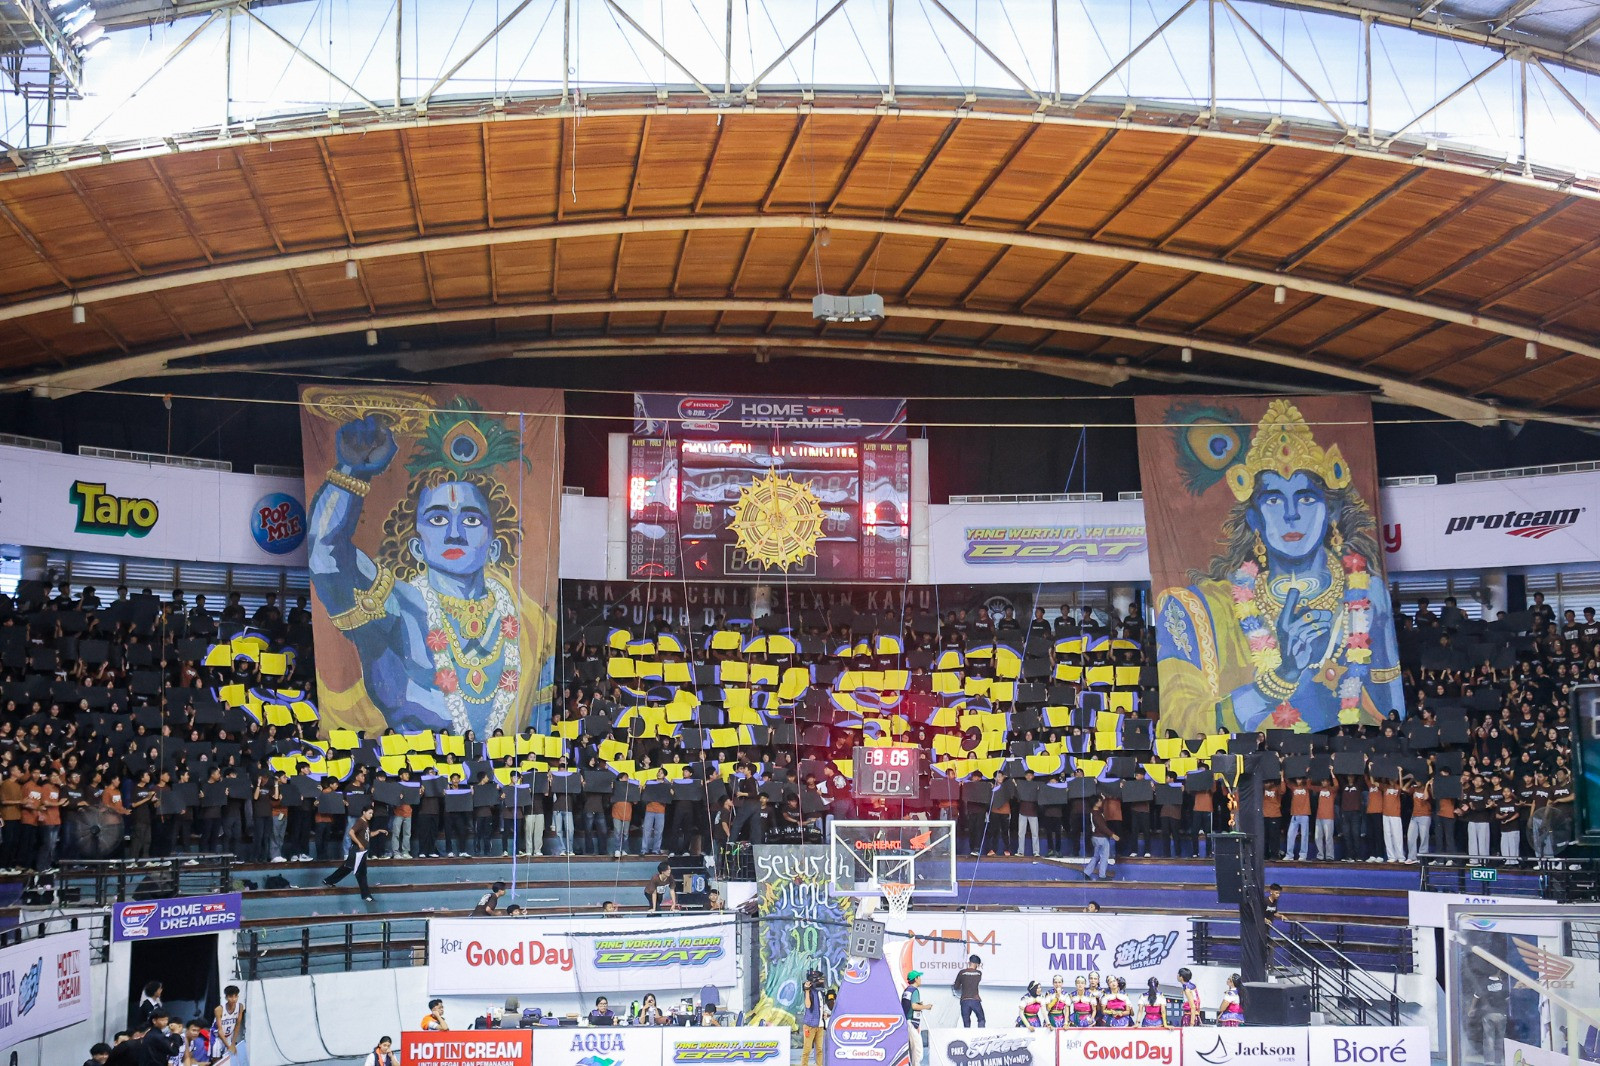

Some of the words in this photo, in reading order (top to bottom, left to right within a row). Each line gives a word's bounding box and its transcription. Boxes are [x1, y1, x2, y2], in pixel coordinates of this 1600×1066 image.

[741, 403, 804, 415] HOME
[741, 416, 862, 429] DREAMERS
[632, 439, 646, 447] PLAYER
[72, 481, 159, 532] Taro
[696, 505, 710, 513] FOULS
[258, 502, 290, 528] POP
[1445, 508, 1580, 535] proteam
[267, 516, 302, 542] MIE
[966, 528, 1007, 540] YANG
[1009, 528, 1061, 539] WORTH
[1085, 527, 1103, 537] YA
[1105, 526, 1145, 537] CUMA
[631, 587, 672, 603] ADA
[867, 590, 930, 610] KAMU
[855, 841, 873, 850] One
[1473, 870, 1494, 879] EXIT
[161, 904, 202, 918] HOME
[160, 912, 236, 930] DREAMERS
[595, 940, 623, 949] YANG
[625, 939, 661, 949] WORTH
[679, 939, 692, 947] YA
[692, 937, 721, 946] CUMA
[1041, 932, 1107, 951] ULTRA
[466, 941, 524, 966] Good
[529, 941, 573, 971] Day
[1048, 953, 1100, 972] MILK
[920, 962, 984, 970] DISTRIBUTR
[225, 1026, 231, 1035] 5
[850, 1031, 868, 1040] DBL
[464, 1042, 522, 1059] CREAM
[570, 1033, 625, 1055] AQUA
[1235, 1042, 1296, 1056] Jackson
[1333, 1038, 1407, 1063] Bioré
[951, 1047, 964, 1056] PAKE
[1083, 1040, 1133, 1060] Good
[1135, 1040, 1173, 1065] Day
[983, 1058, 1002, 1066] MAKIN
